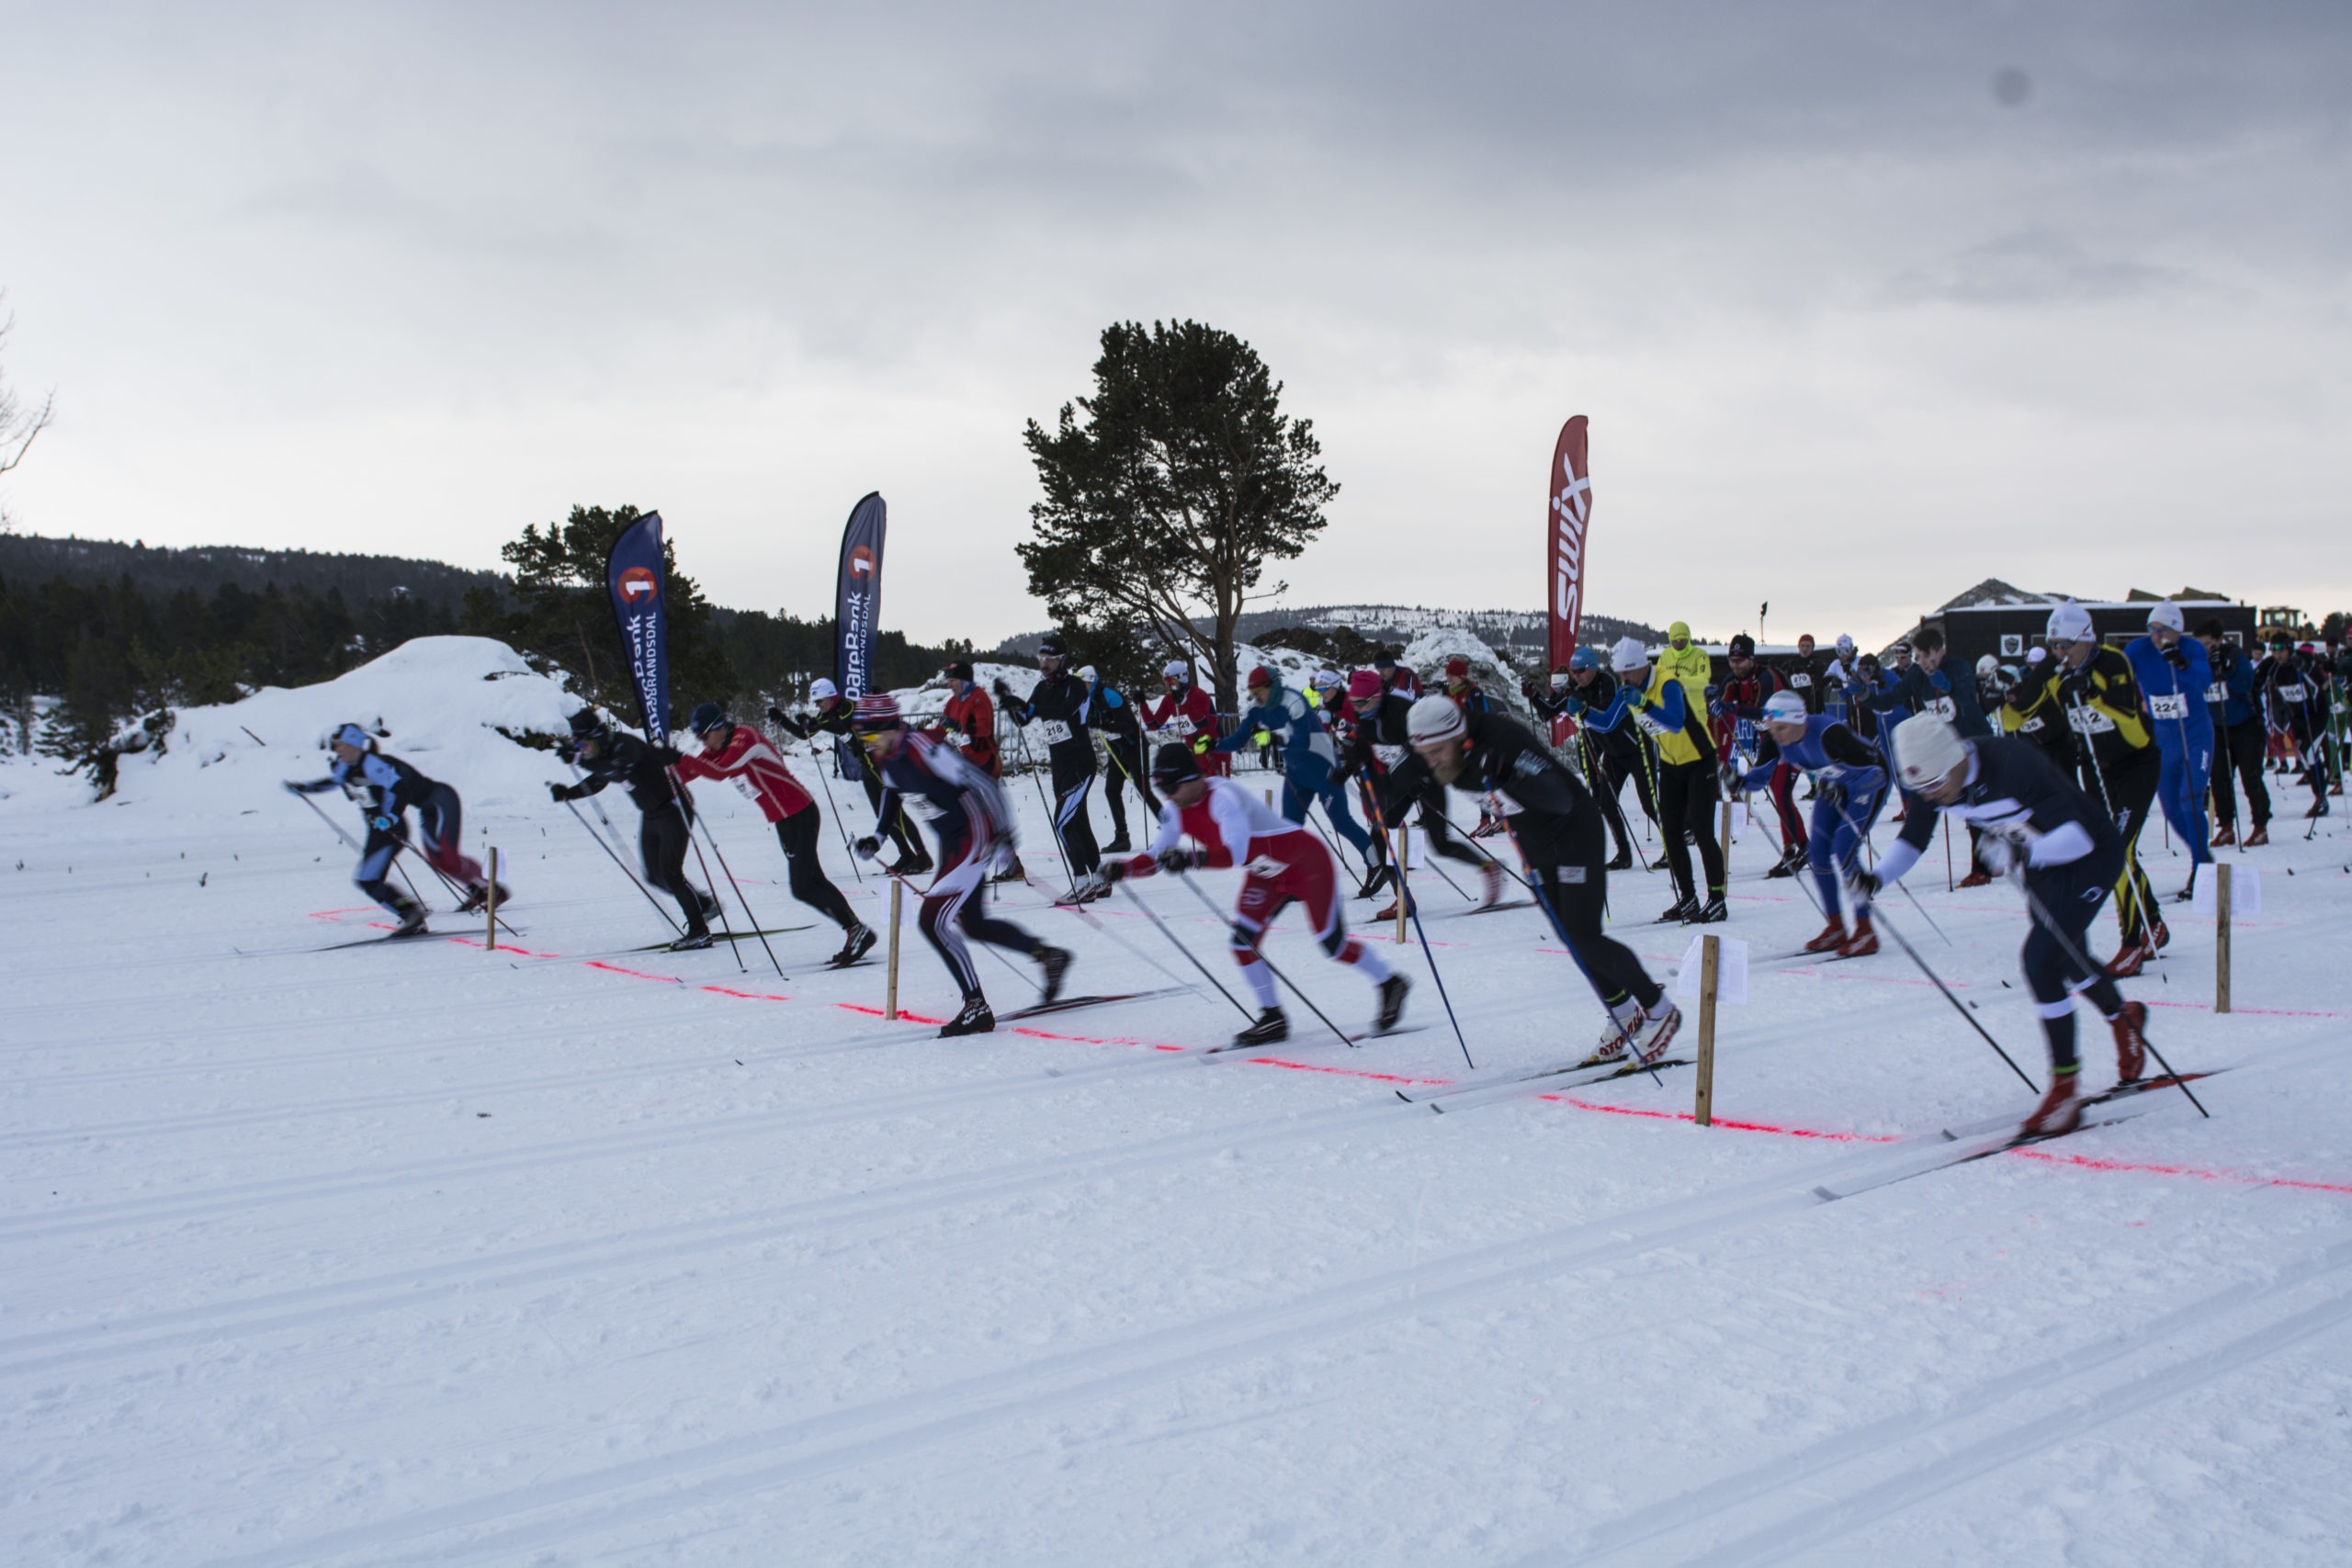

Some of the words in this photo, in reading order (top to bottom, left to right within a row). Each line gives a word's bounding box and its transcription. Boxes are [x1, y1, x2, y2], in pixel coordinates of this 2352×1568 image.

[845, 591, 862, 701] pareBank
[1046, 724, 1064, 737] 218
[1179, 720, 1190, 728] 29
